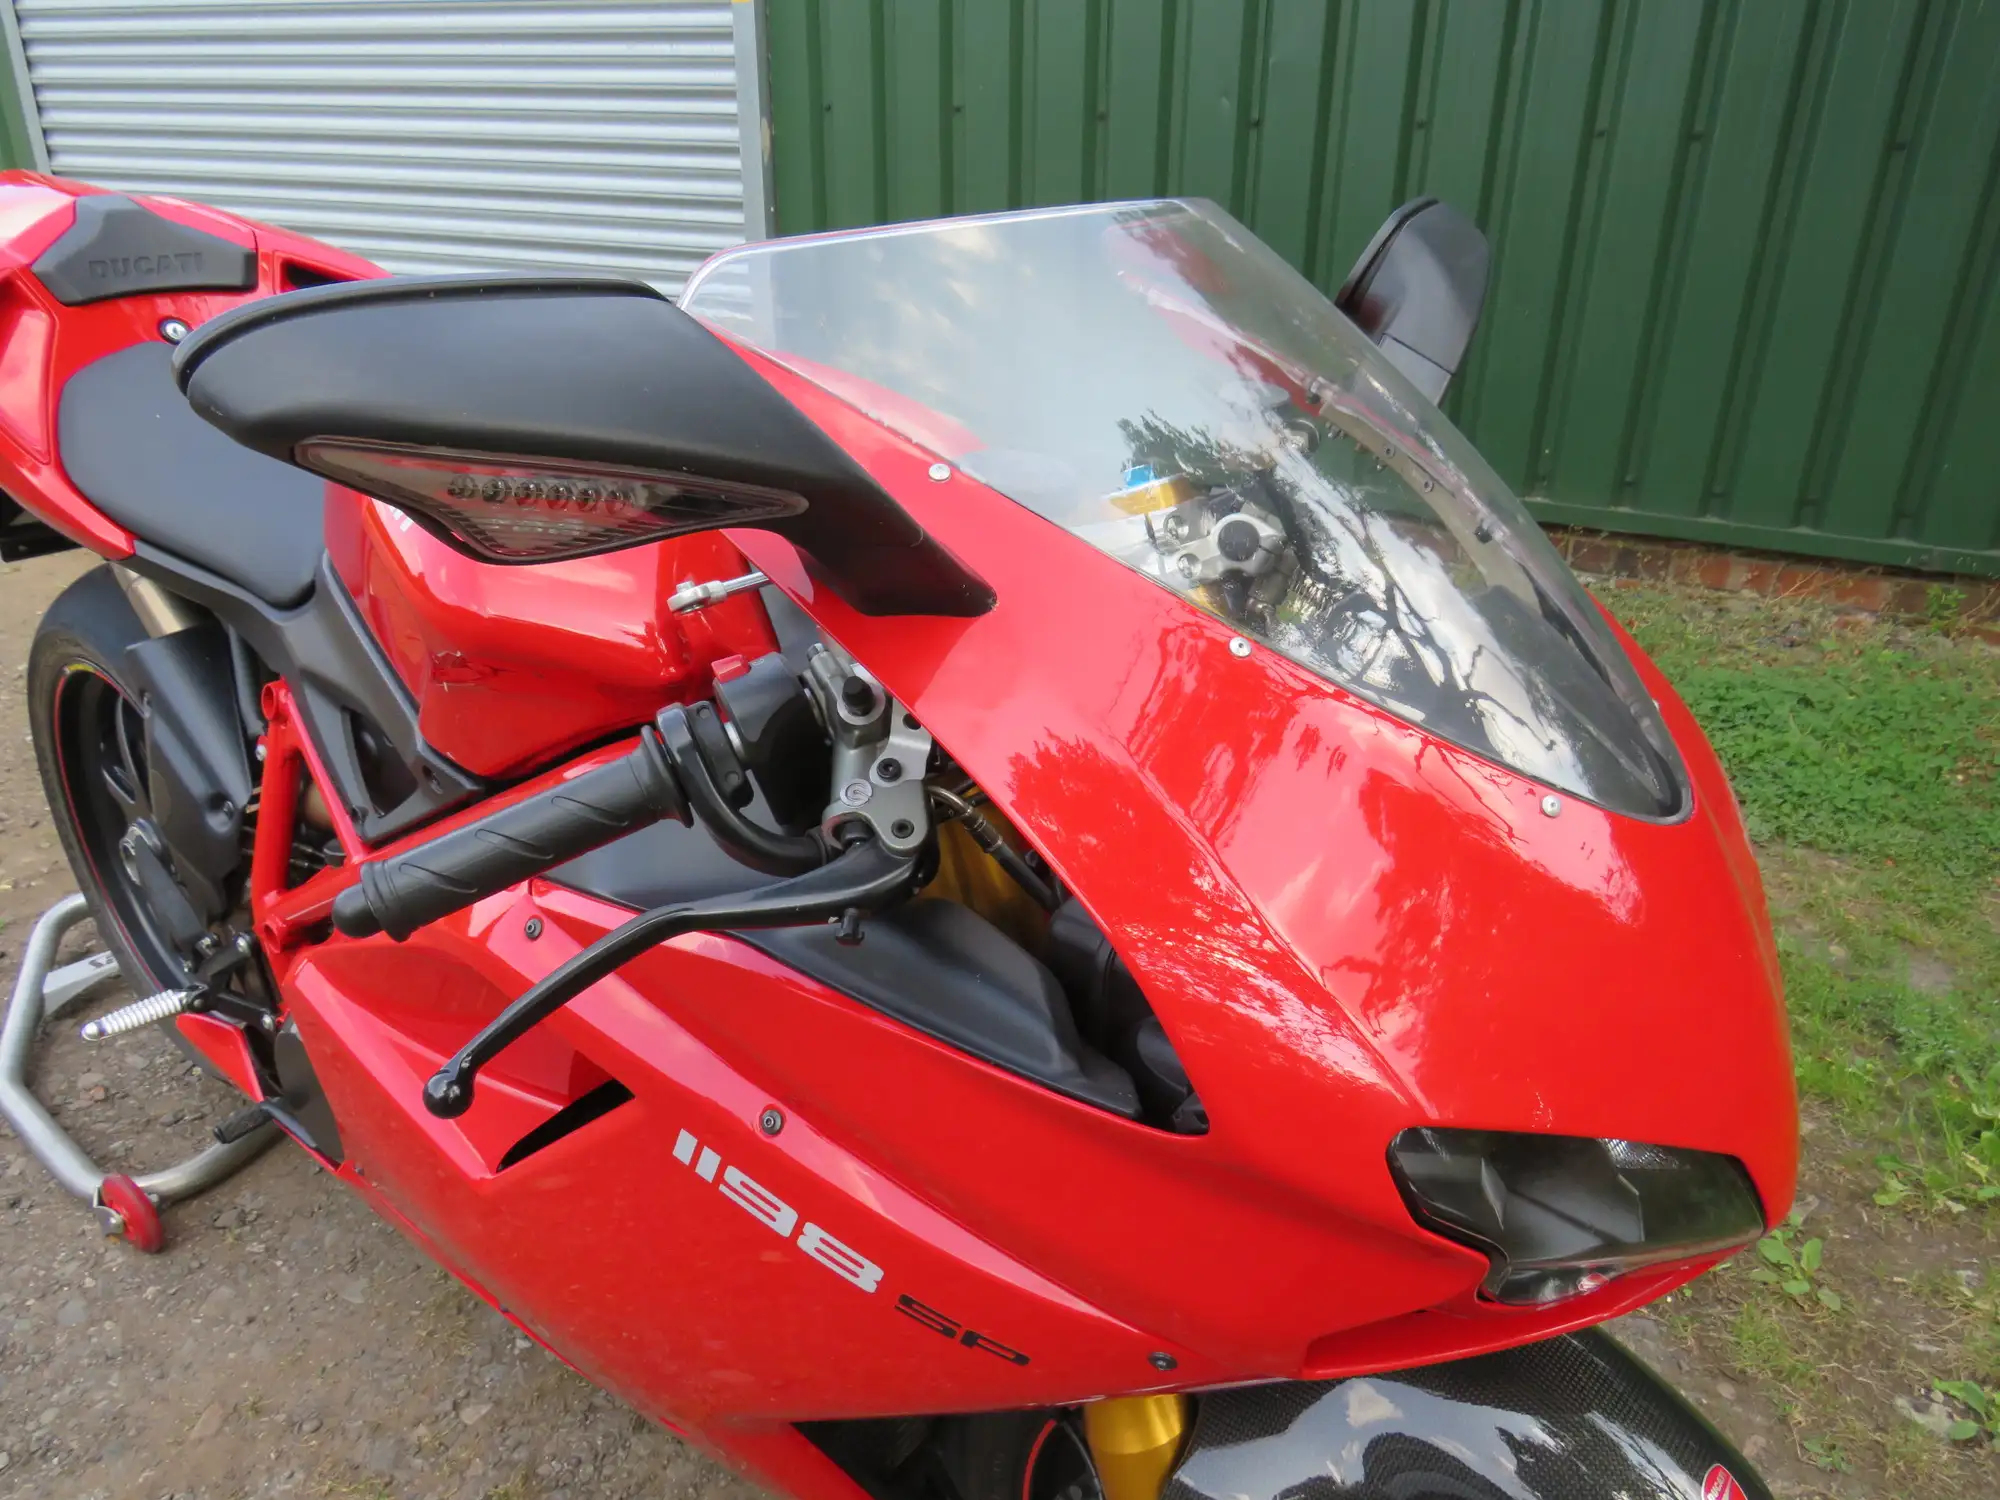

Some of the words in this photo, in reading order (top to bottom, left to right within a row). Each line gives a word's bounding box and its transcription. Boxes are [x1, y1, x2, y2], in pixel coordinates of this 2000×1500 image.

[88, 252, 203, 278] DUCATI
[672, 1128, 884, 1293] 1198
[894, 1294, 1031, 1366] SP
